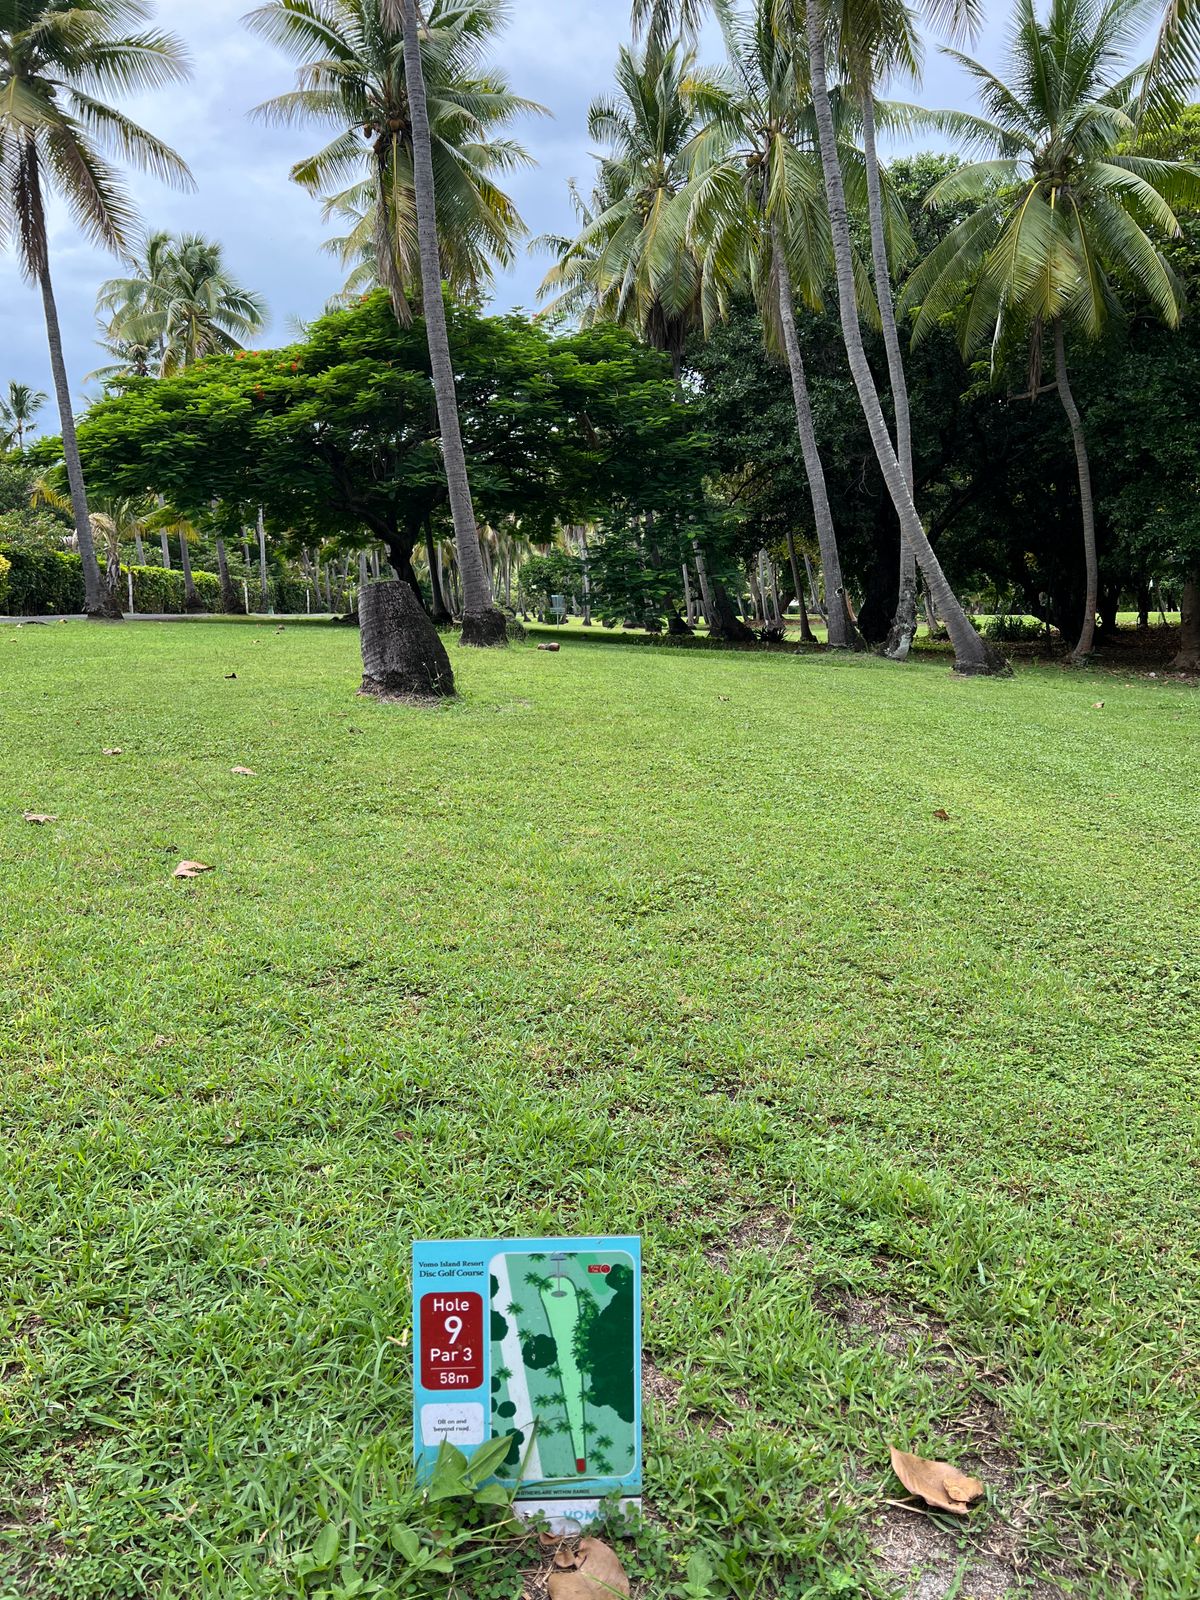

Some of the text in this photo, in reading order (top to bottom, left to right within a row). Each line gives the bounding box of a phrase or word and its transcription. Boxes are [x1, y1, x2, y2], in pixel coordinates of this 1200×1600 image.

[420, 1269, 484, 1278] Disc Golf Course
[433, 1298, 470, 1312] Hole
[444, 1315, 463, 1345] 9
[430, 1347, 472, 1362] Par 3
[440, 1372, 469, 1384] 58m
